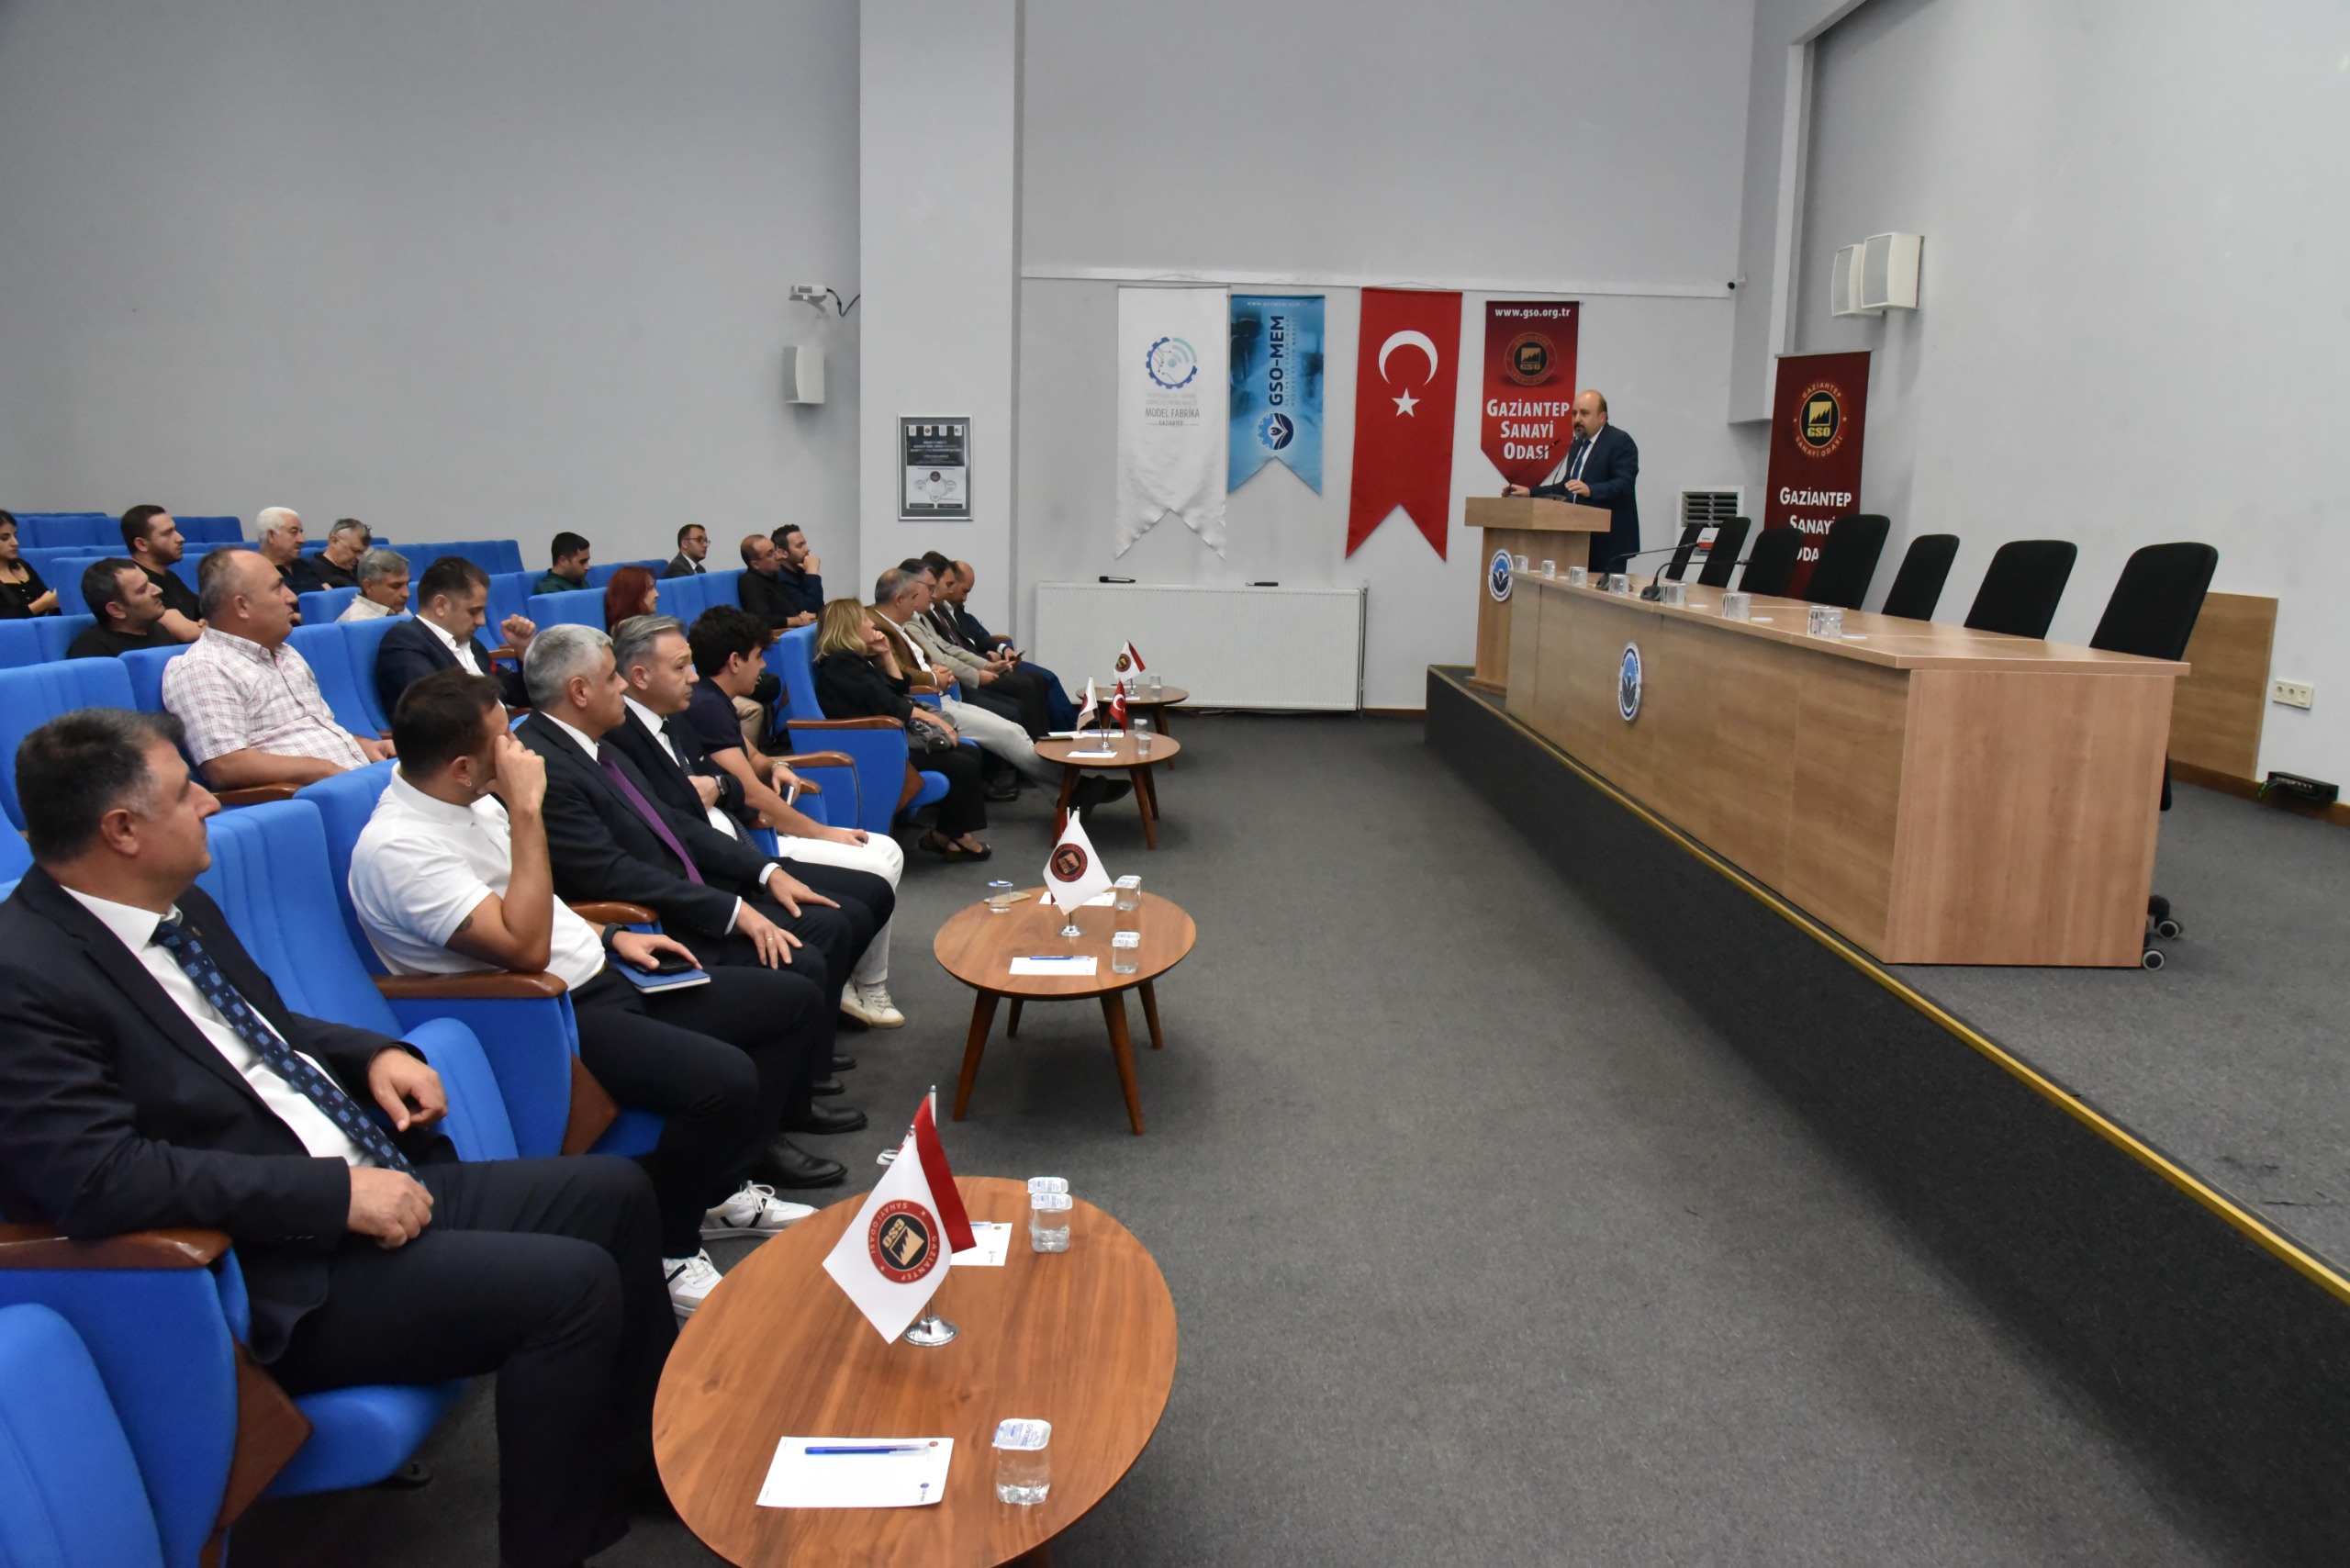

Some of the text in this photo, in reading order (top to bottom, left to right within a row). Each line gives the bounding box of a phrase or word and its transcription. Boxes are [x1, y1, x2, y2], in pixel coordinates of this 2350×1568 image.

[1494, 308, 1571, 319] www.gso.org.tr
[1269, 315, 1284, 406] GSO-MEM
[1145, 407, 1200, 418] MODEL FABRİKA
[1486, 398, 1570, 417] GAZİANTEP
[1500, 420, 1554, 439] SANAYİ
[1807, 427, 1831, 438] GSO
[1503, 442, 1549, 460] ODASI
[1779, 486, 1852, 508] GAZİANTEP
[882, 1217, 905, 1249] GSO
